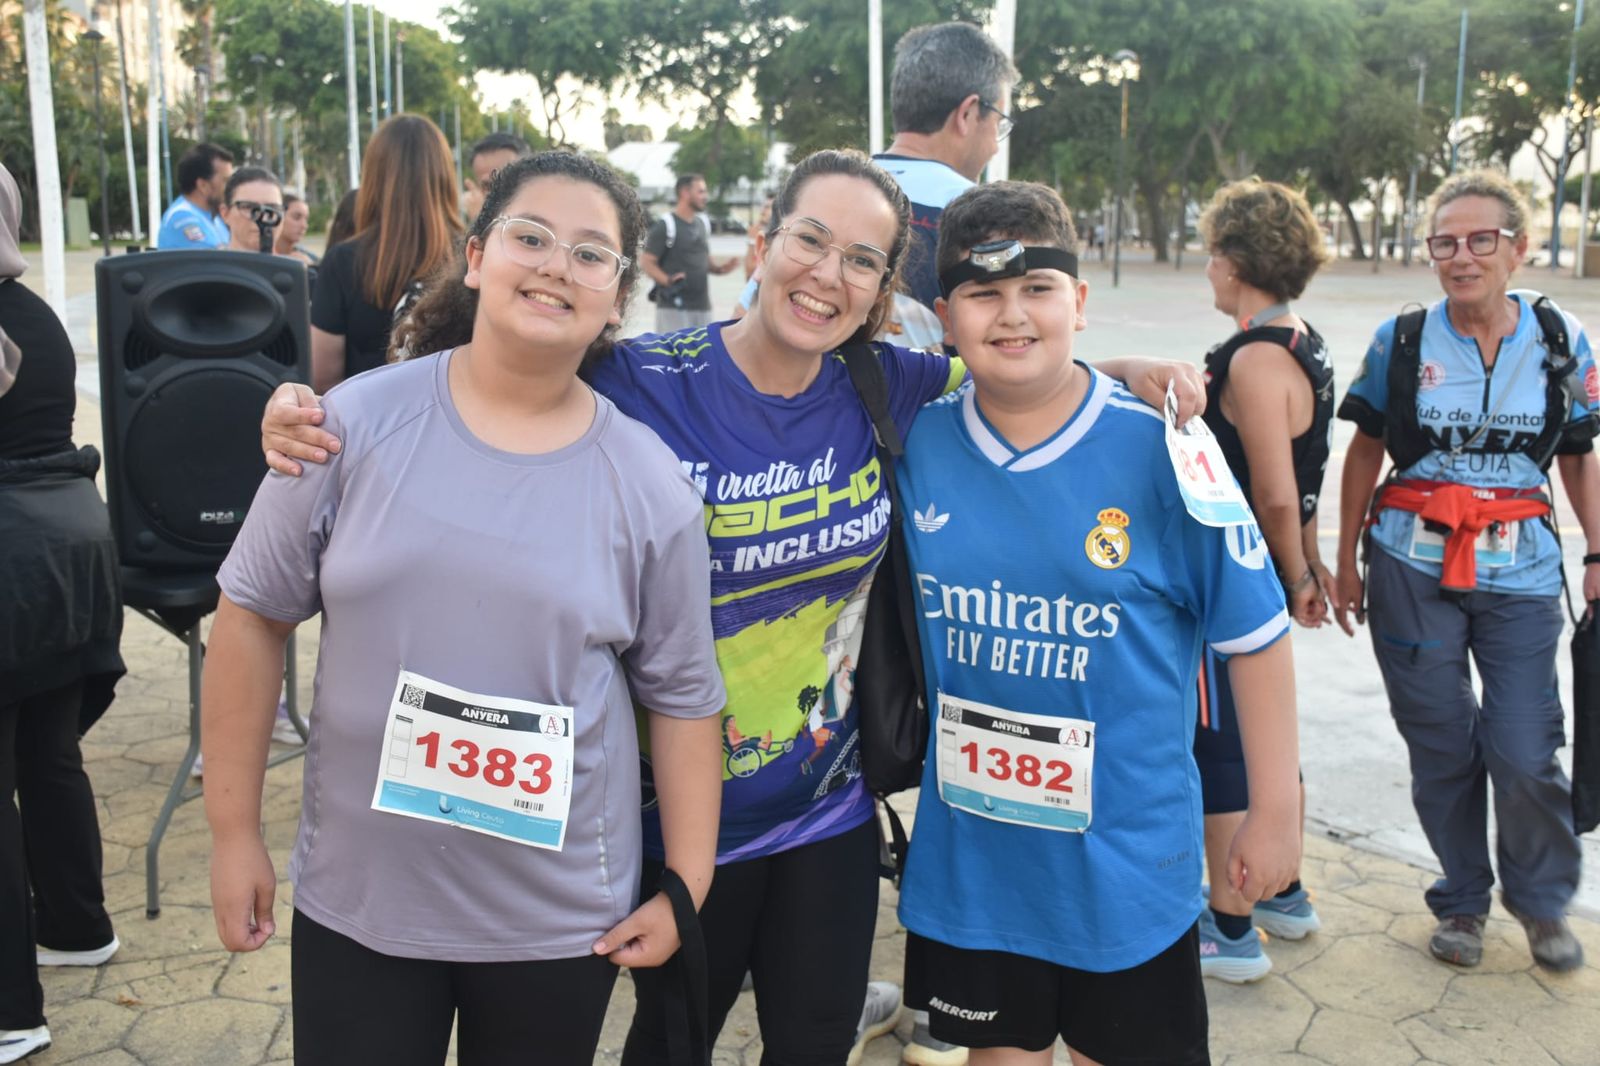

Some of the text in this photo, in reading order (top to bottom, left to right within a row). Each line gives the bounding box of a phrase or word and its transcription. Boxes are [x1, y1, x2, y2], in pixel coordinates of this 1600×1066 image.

[1448, 408, 1472, 423] de
[808, 447, 837, 486] al
[703, 456, 881, 538] ACHO
[916, 572, 1121, 638] Emirates
[946, 626, 1090, 682] FLY BETTER
[461, 707, 509, 725] ANYERA
[992, 720, 1031, 736] ANYERA
[416, 731, 553, 795] 1383
[960, 741, 1074, 793] 1382
[929, 997, 999, 1021] MERCURY
